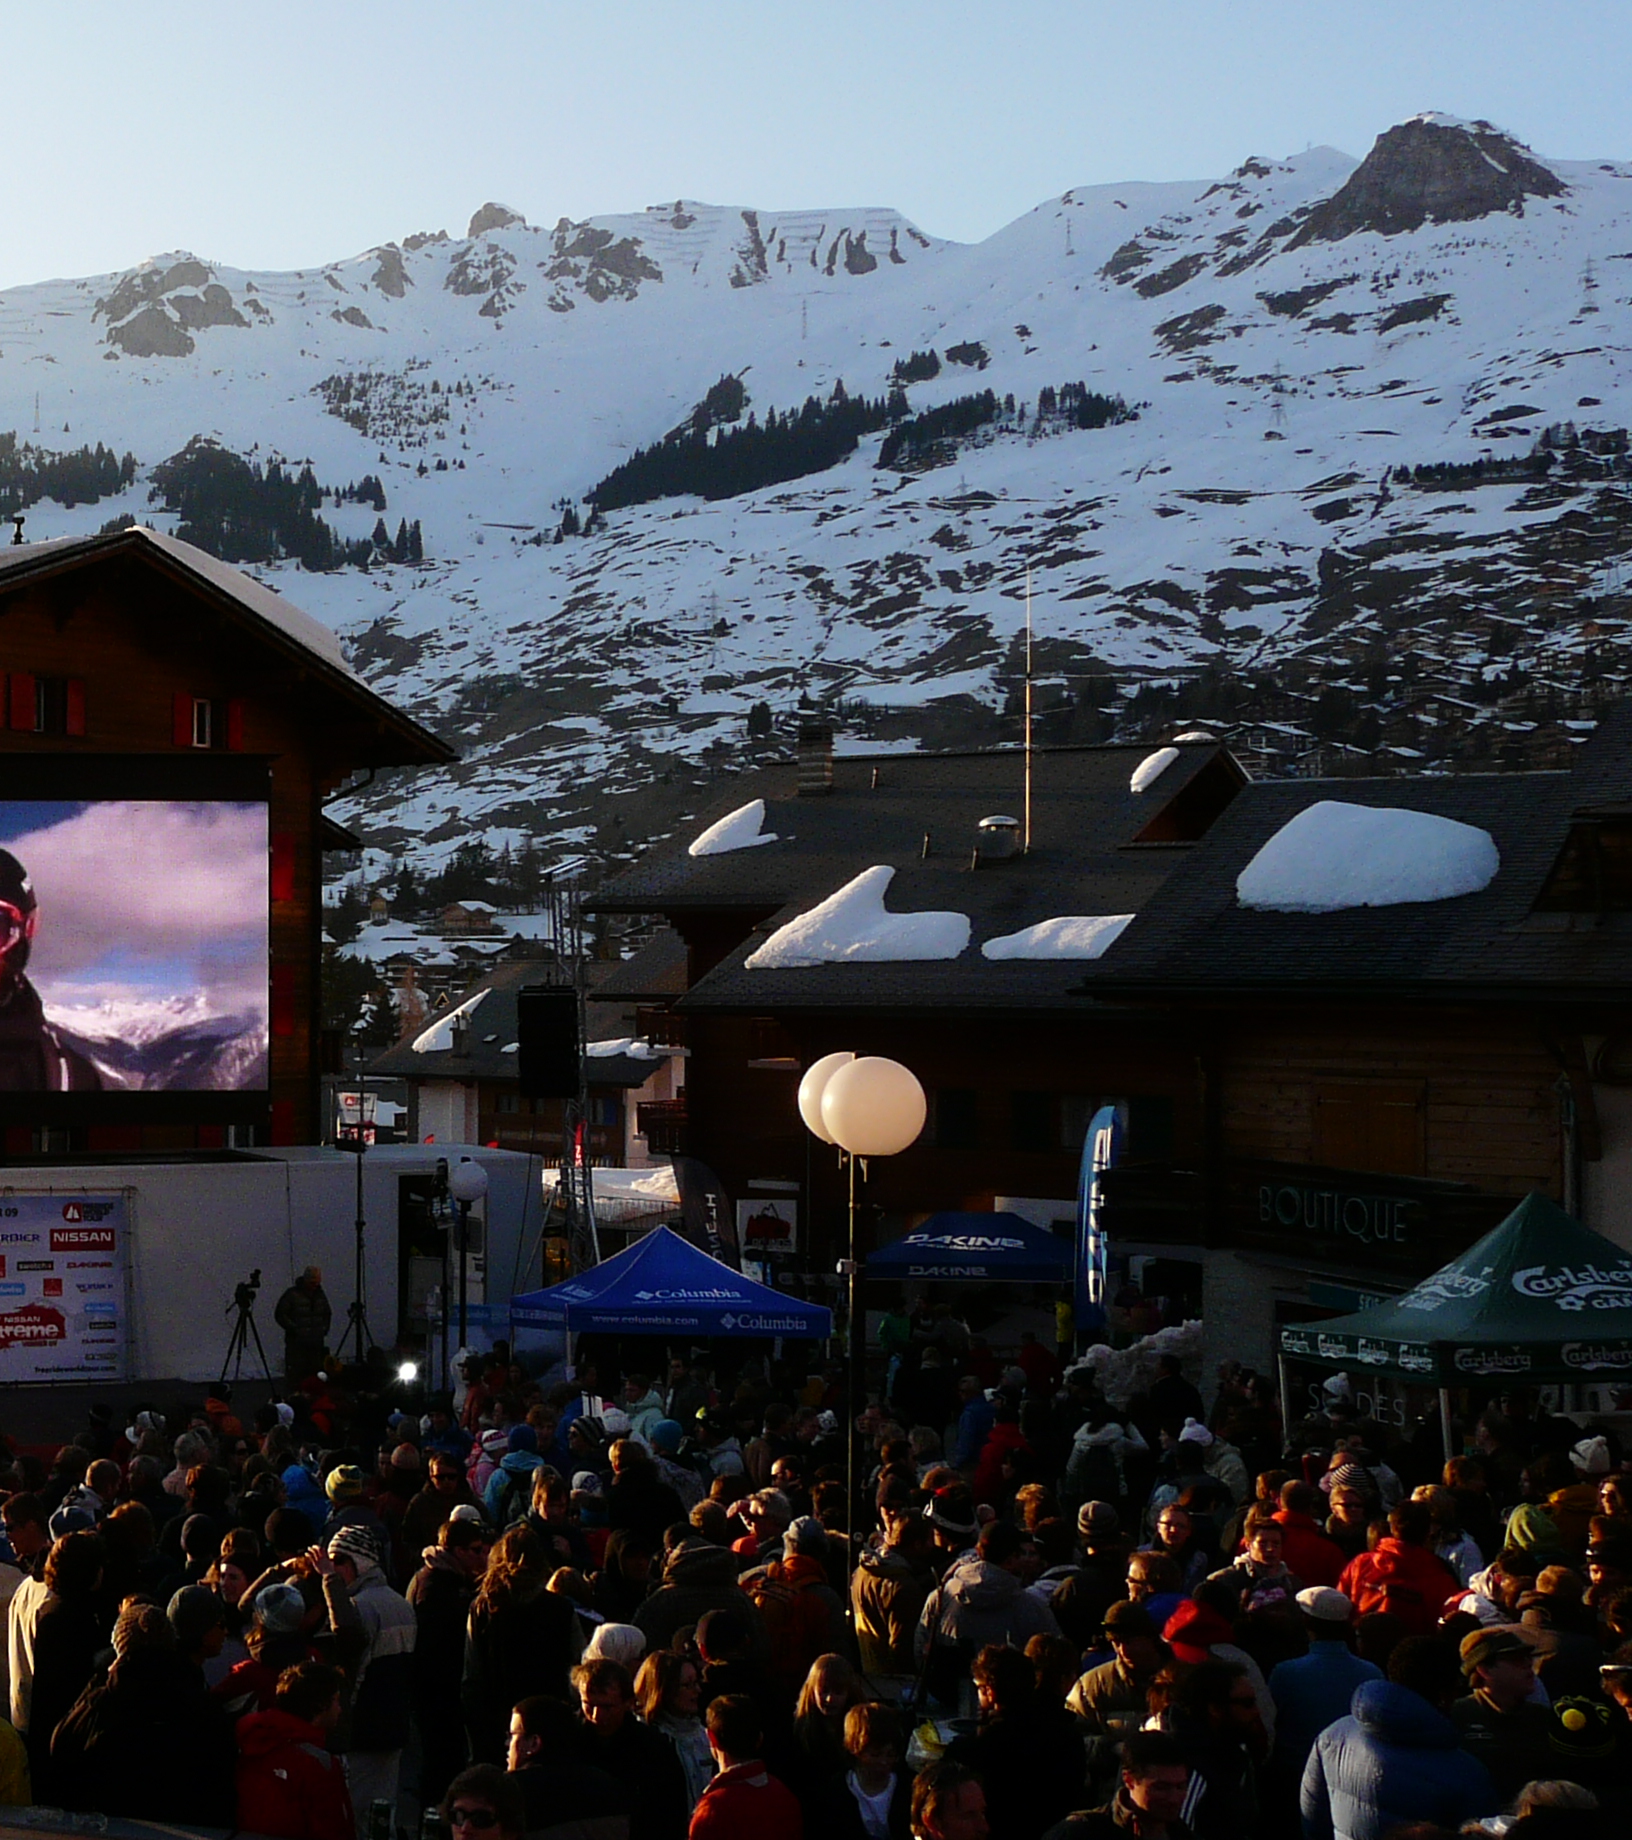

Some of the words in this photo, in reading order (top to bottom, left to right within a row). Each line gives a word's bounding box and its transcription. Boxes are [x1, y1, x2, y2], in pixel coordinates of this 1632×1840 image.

[5, 1207, 18, 1217] 09
[1258, 1185, 1408, 1244] BOUTIQUE
[53, 1231, 112, 1243] NISSAN
[902, 1233, 1028, 1250] DAKINE
[908, 1265, 989, 1277] DAKINE
[1512, 1263, 1632, 1297] Carlsbe
[654, 1288, 742, 1299] Columbia
[4, 1315, 41, 1324] NISSAN
[591, 1314, 699, 1326] www.columbia.com
[737, 1313, 808, 1331] Columbia
[1453, 1347, 1532, 1374] Carlsberg
[1308, 1383, 1405, 1427] SDES
